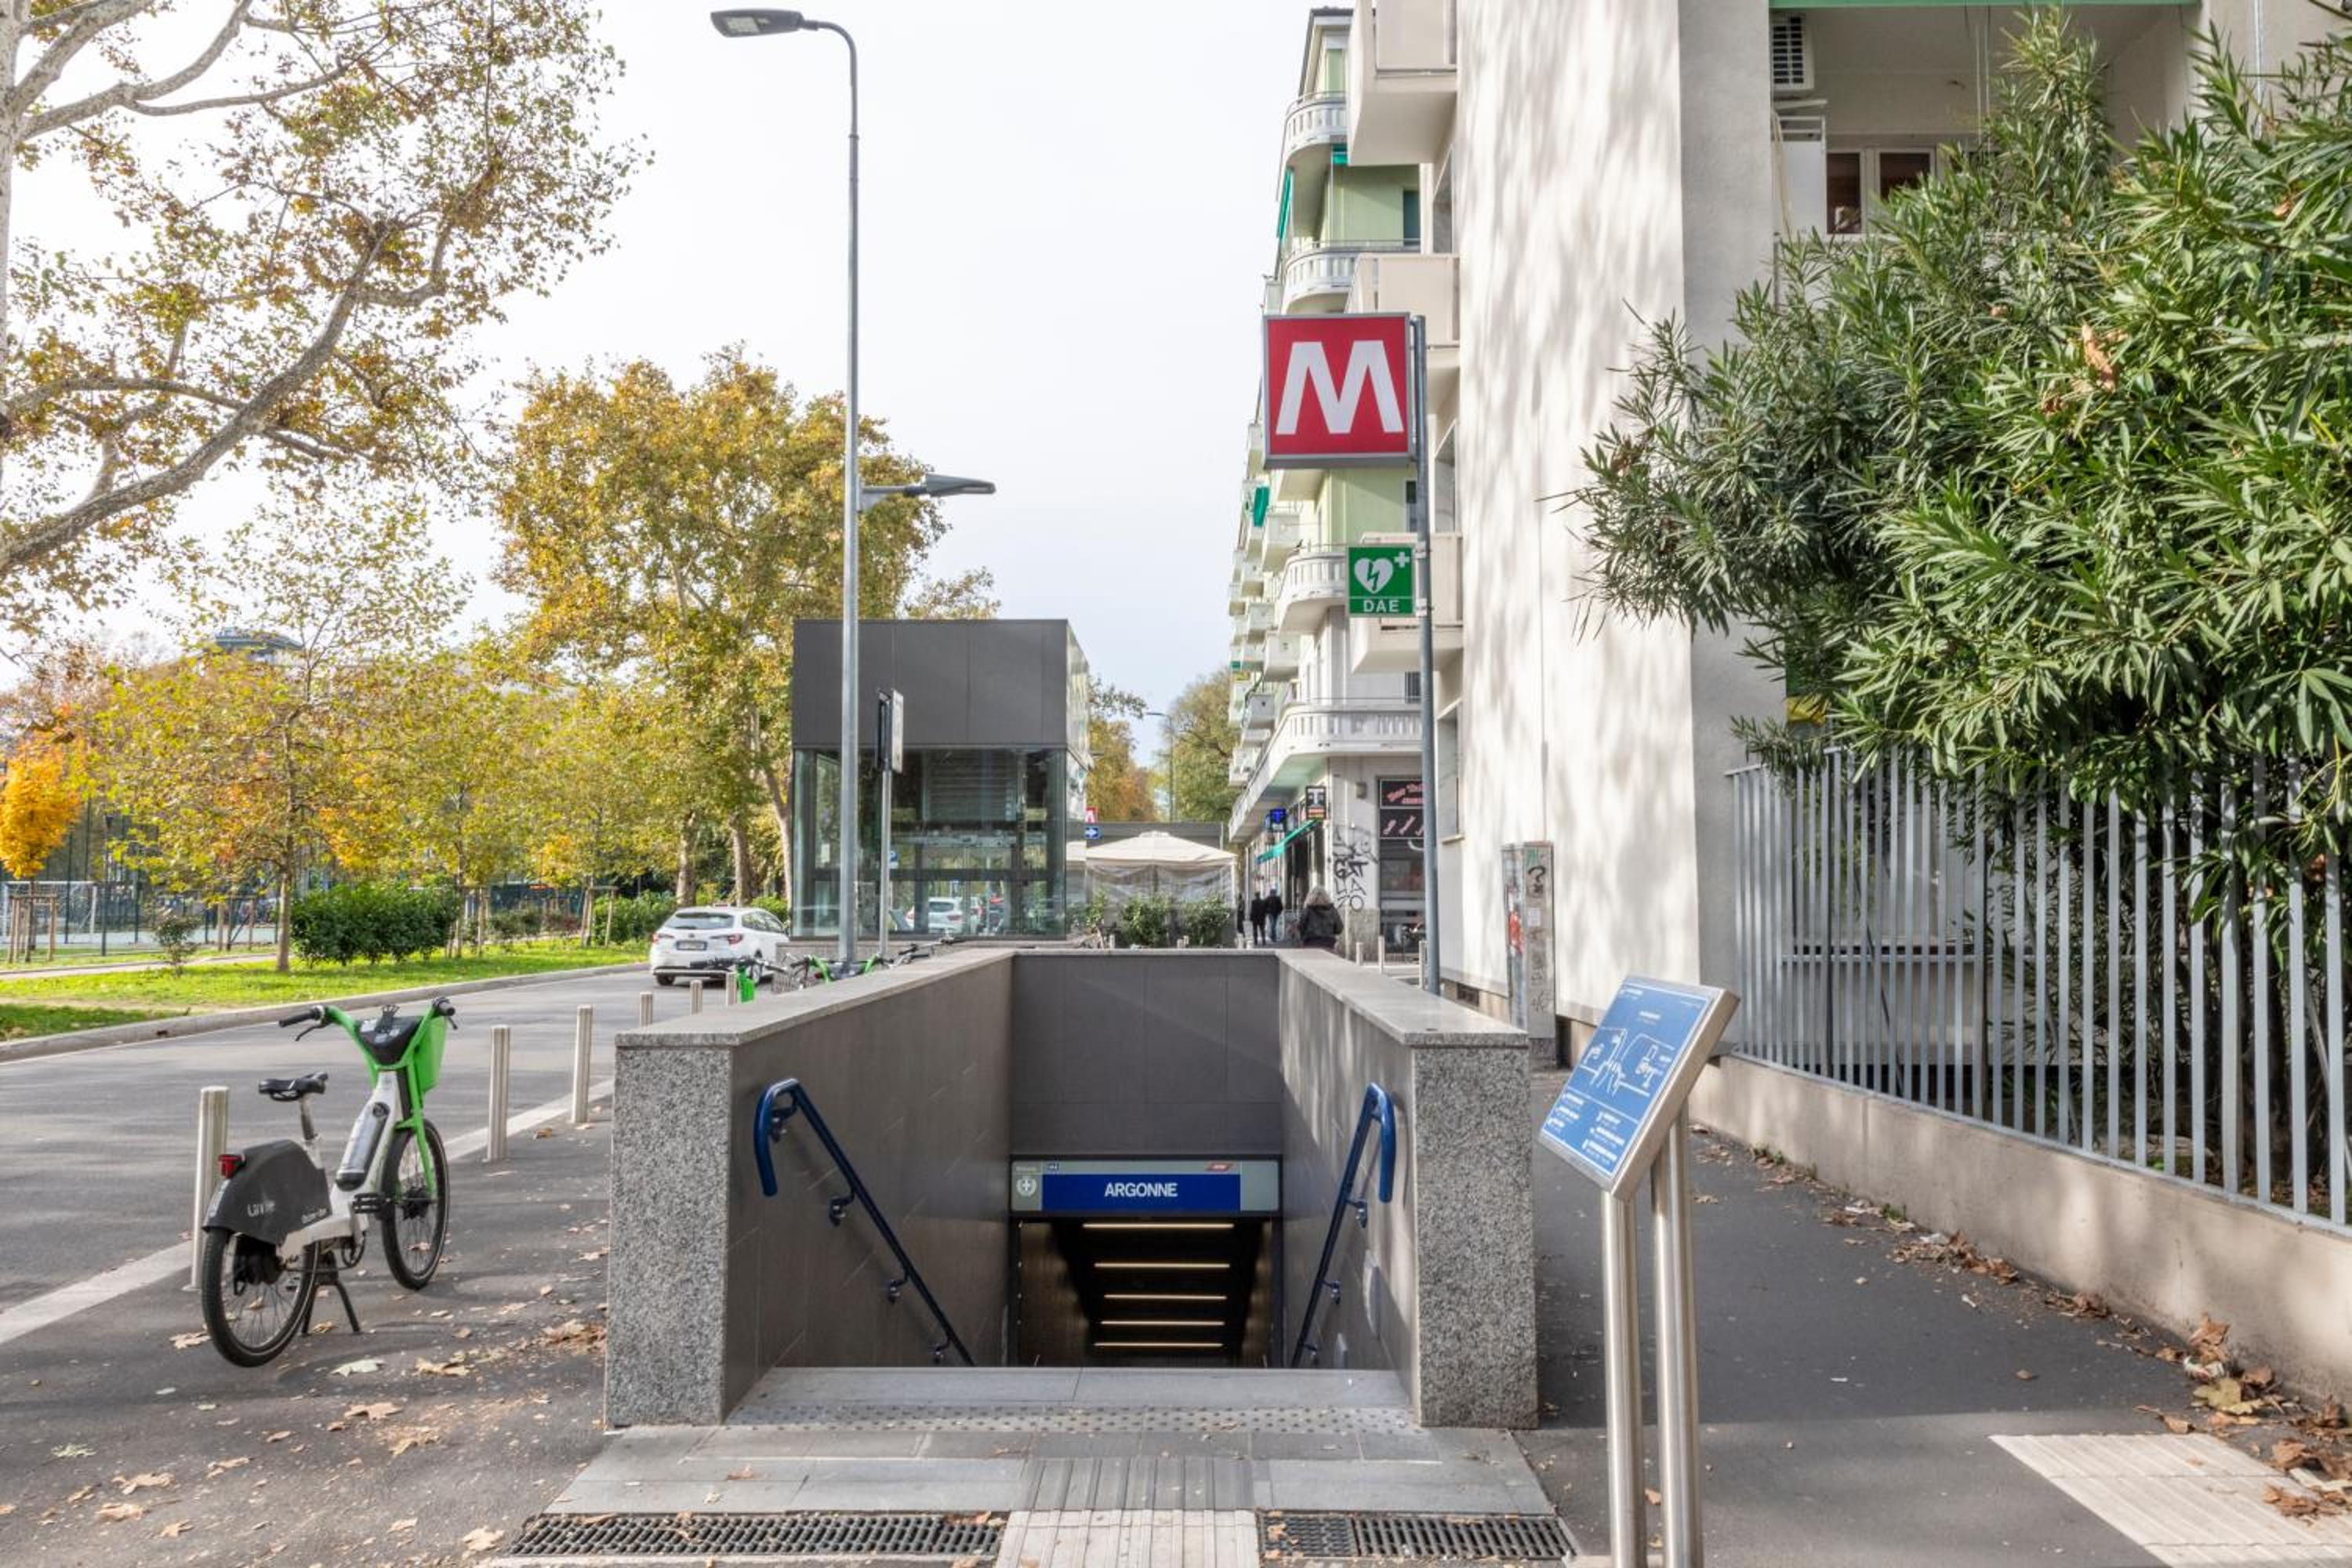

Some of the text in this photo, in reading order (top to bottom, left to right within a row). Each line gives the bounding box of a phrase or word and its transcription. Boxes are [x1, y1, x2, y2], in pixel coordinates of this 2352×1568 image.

[1276, 340, 1404, 434] M
[1363, 599, 1400, 613] DAE
[1105, 1182, 1178, 1197] ARGONNE
